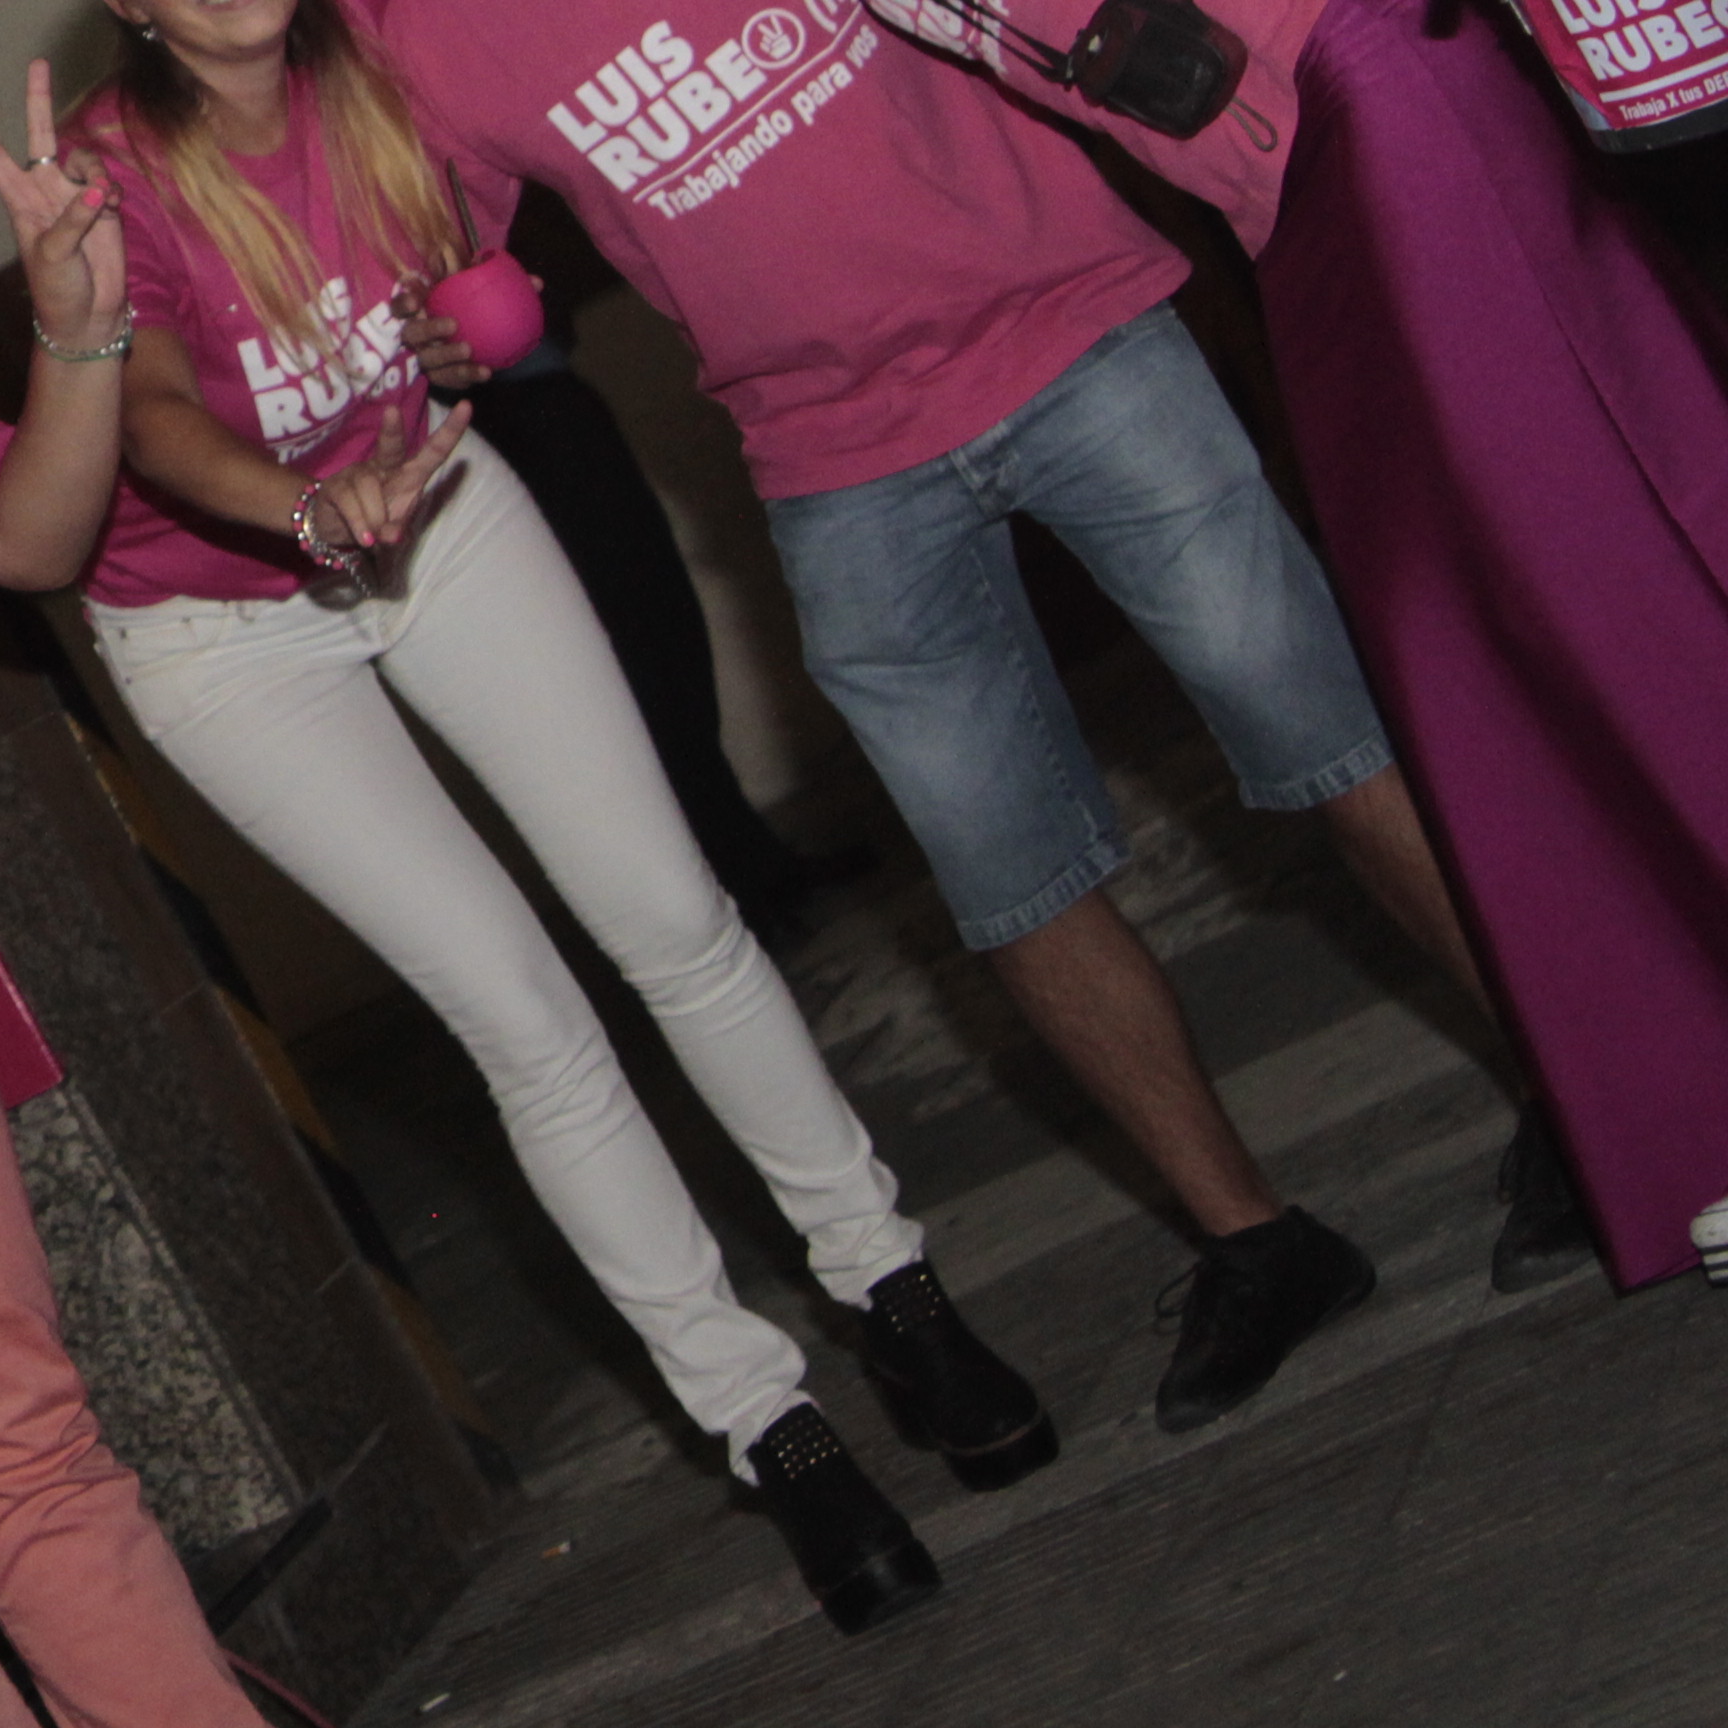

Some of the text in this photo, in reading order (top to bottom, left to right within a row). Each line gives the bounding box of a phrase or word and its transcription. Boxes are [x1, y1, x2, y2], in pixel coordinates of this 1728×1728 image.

[546, 20, 696, 155] LUIS
[648, 24, 879, 219] Trabajando para vos
[1618, 97, 1667, 122] Trabaja
[1665, 90, 1680, 109] X
[1678, 85, 1704, 105] tus
